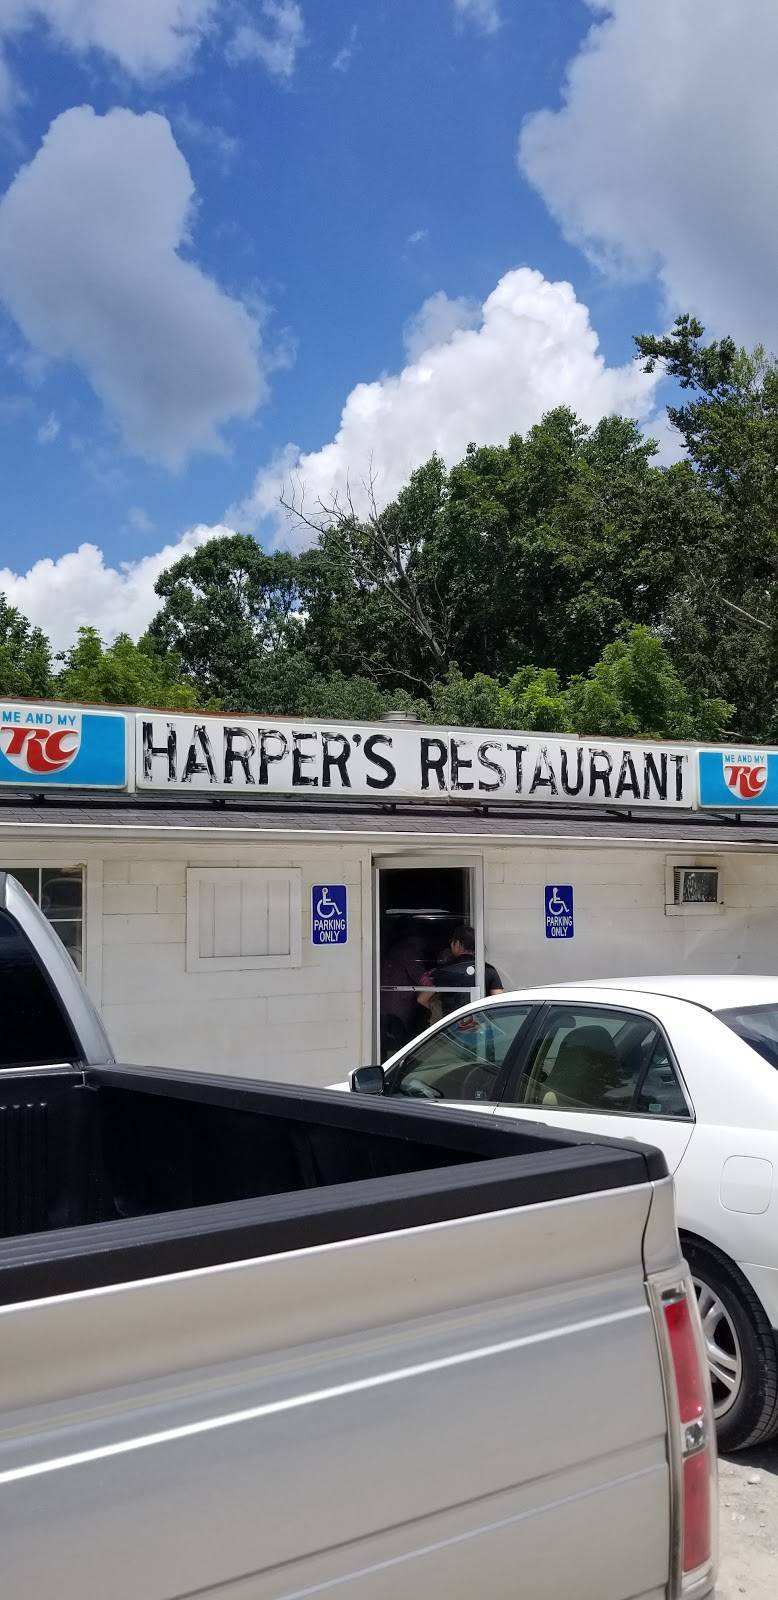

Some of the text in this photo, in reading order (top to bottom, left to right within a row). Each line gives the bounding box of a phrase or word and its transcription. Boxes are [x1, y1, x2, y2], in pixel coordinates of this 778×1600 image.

[2, 711, 76, 726] ME AND MY
[1, 726, 79, 771] RC
[142, 721, 688, 801] HARPER'S RESTAURANT
[725, 766, 766, 798] RC
[314, 919, 345, 930] PARKING
[547, 916, 572, 926] PARKING
[320, 931, 340, 942] ONLY
[552, 927, 568, 936] ONLY
